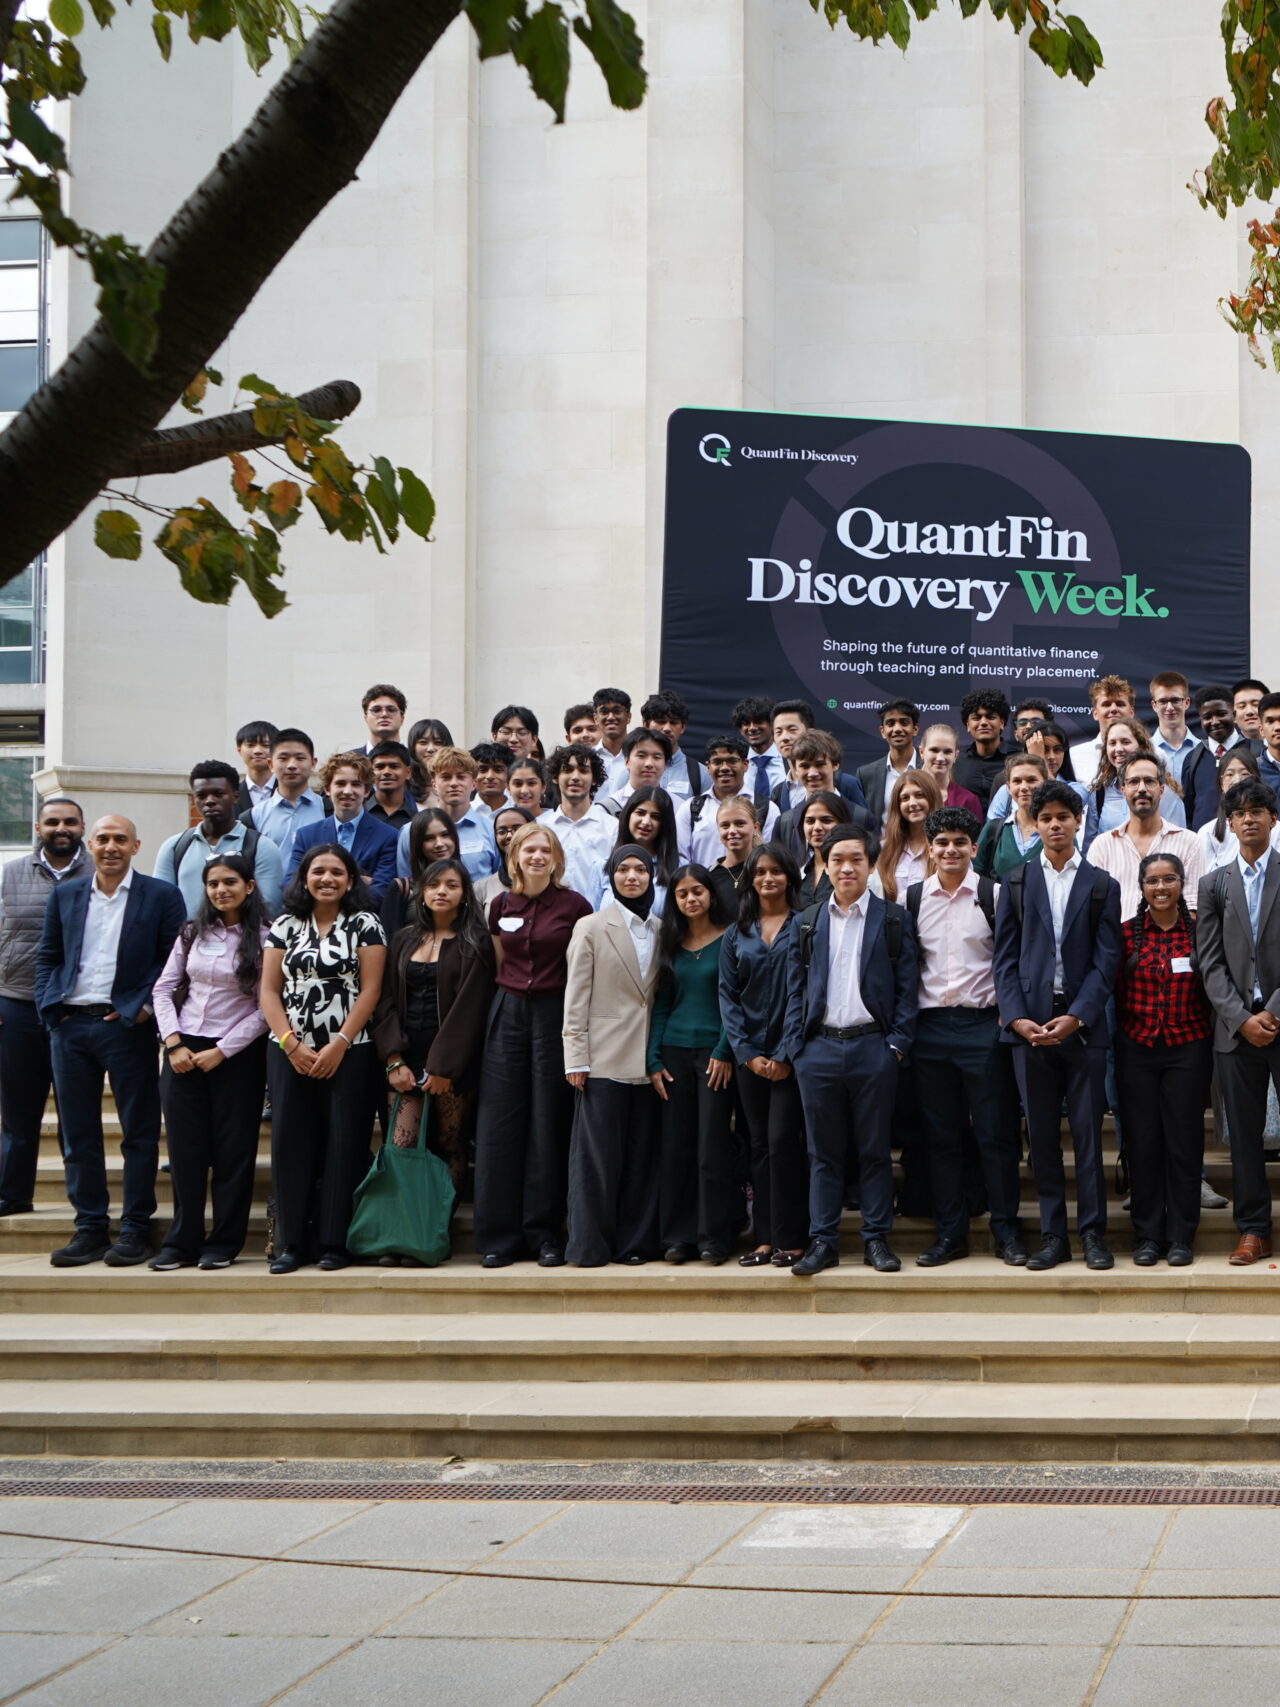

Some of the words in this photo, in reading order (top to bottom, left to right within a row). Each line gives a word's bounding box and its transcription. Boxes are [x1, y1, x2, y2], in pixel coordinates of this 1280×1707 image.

[740, 446, 799, 460] QuantFin
[801, 449, 859, 466] Discovery
[837, 507, 1092, 562] QuantFin
[746, 557, 1011, 622] Discovery
[1015, 569, 1170, 618] Week.
[823, 639, 878, 655] Shaping
[881, 642, 903, 654] the
[907, 642, 947, 655] future
[950, 643, 965, 655] of
[968, 645, 1047, 658] quantitative
[1050, 647, 1099, 659] finance
[820, 660, 874, 675] through
[877, 662, 936, 677] teaching
[939, 664, 964, 675] and
[968, 664, 1023, 679] industry
[1026, 666, 1100, 679] placement.
